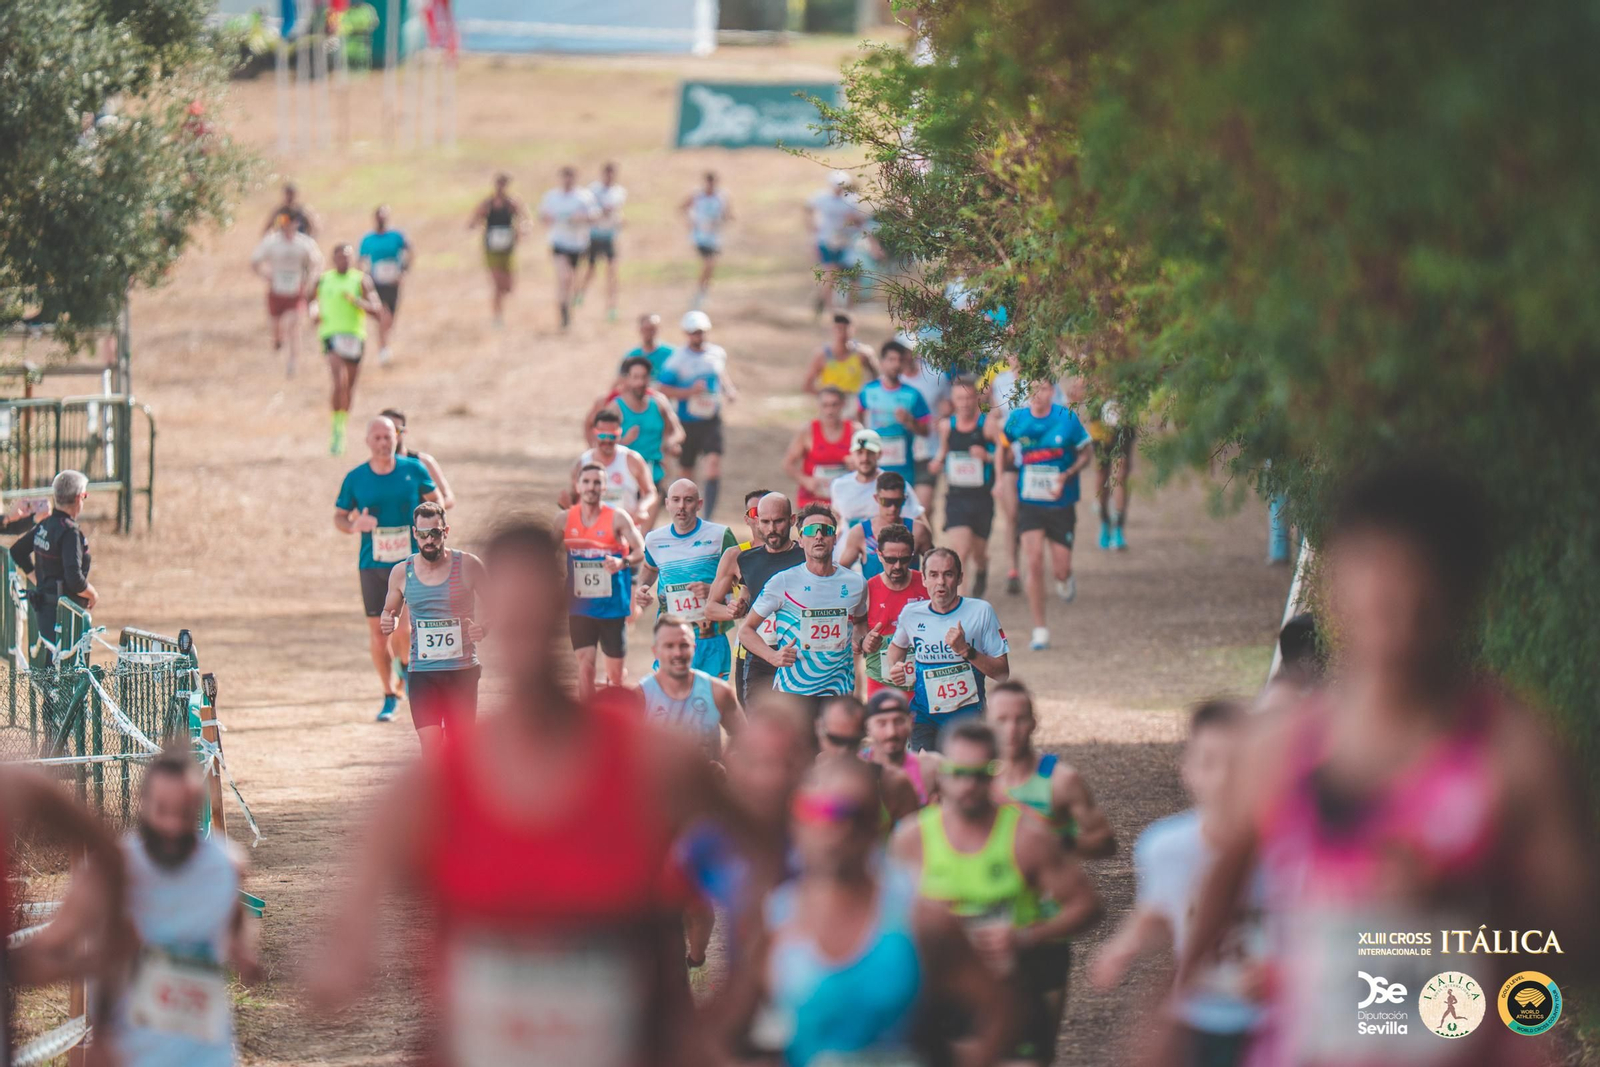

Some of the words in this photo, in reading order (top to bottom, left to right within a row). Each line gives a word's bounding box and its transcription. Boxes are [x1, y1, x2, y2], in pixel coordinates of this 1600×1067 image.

[584, 573, 600, 586] 65
[675, 596, 702, 612] 141
[425, 632, 455, 648] 376
[810, 624, 841, 640] 294
[937, 680, 969, 700] 453
